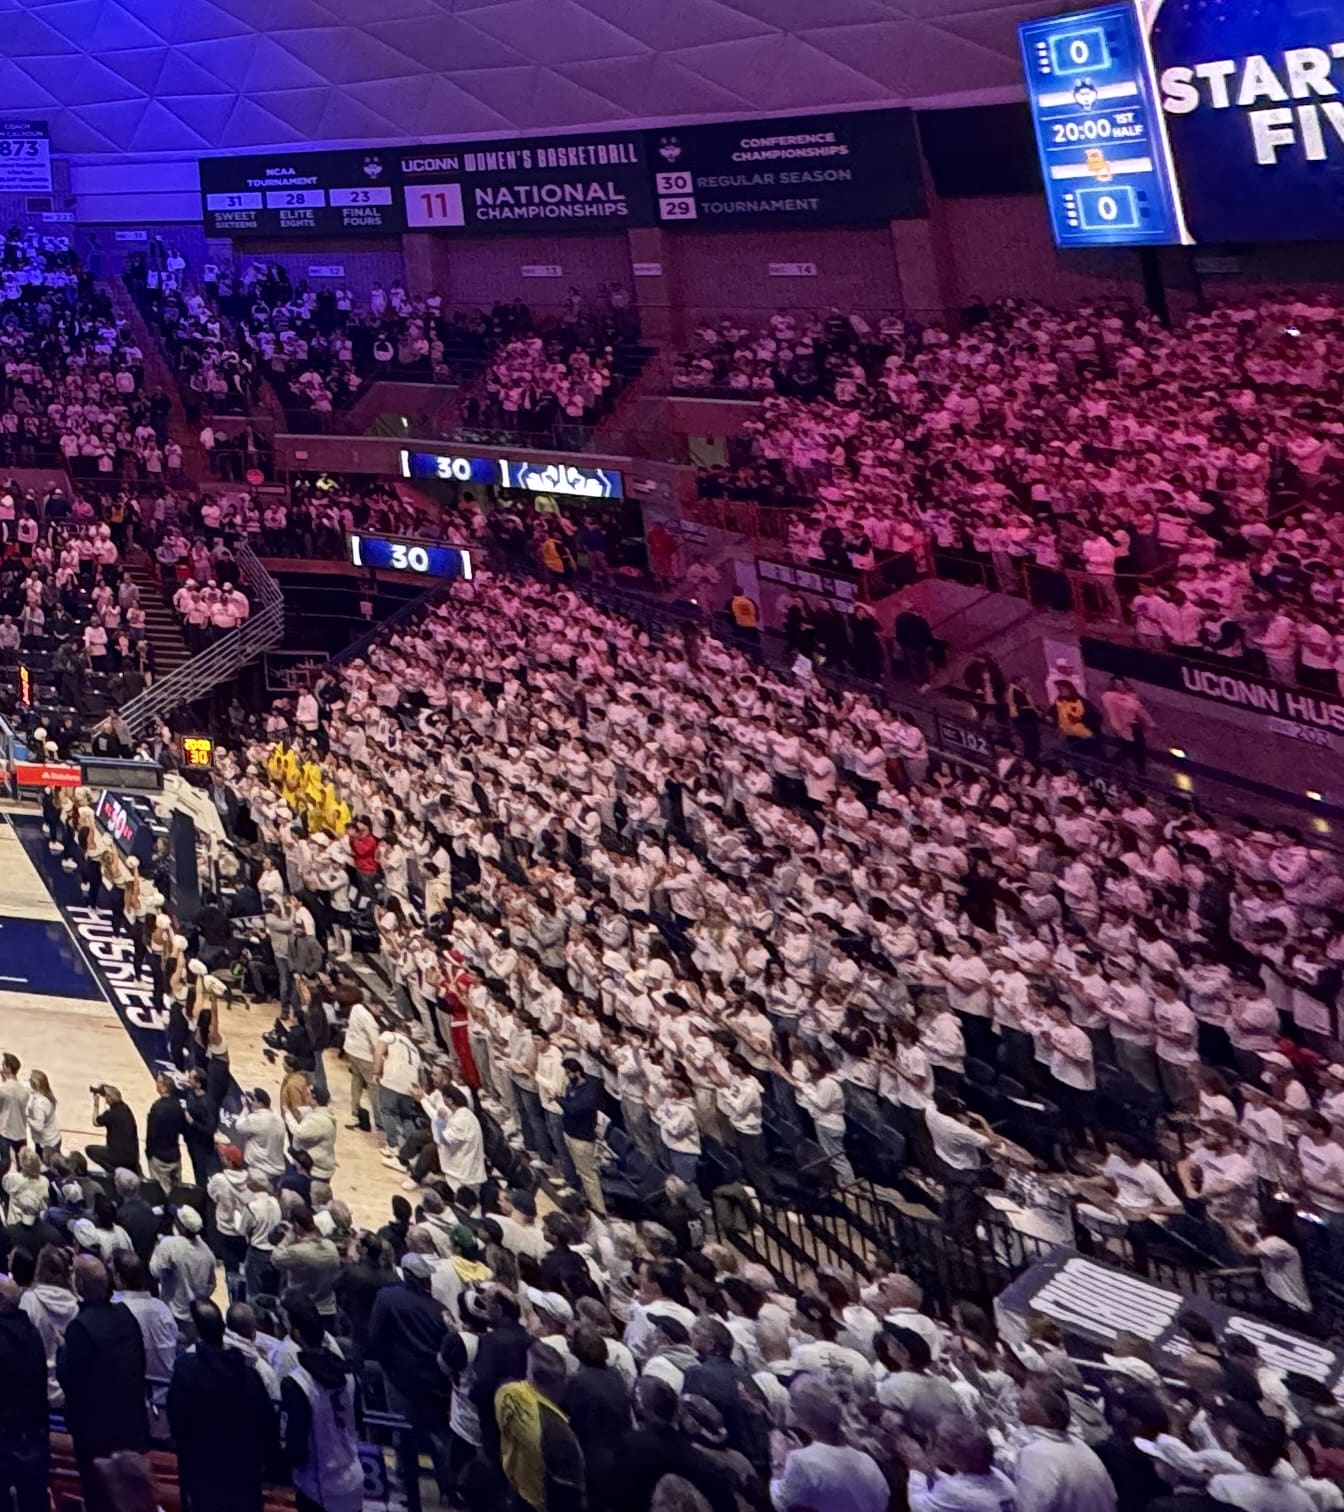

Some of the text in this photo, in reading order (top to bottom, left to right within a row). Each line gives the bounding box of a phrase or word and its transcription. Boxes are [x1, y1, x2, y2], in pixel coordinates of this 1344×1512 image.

[1070, 40, 1089, 64] 0
[1053, 118, 1111, 143] 20:00
[1113, 124, 1143, 137] HALF
[0, 141, 39, 157] 873
[740, 133, 836, 148] CONFERENCE
[401, 143, 638, 172] UCONN WOMEN'S BASKETBALL
[731, 145, 848, 161] CHAMPIONSHIPS
[266, 168, 296, 176] NCAA
[662, 169, 852, 190] 30 REGULAR SEASON
[247, 177, 318, 187] TOURNAMENT
[227, 192, 370, 207] 31 28 23
[475, 182, 625, 206] NATIONAL
[215, 208, 380, 221] SWEET ELITE FINAL
[420, 193, 447, 219] 11
[476, 203, 628, 220] CHAMPIONSHIPS
[666, 198, 819, 215] 29 TOURNAMENT
[1098, 196, 1118, 221] 0
[215, 217, 382, 229] SIXTEENS EIGHTS FOURS
[436, 457, 471, 481] 30
[391, 544, 429, 572] 30
[1182, 666, 1280, 714] UCONN
[960, 730, 988, 755] 102
